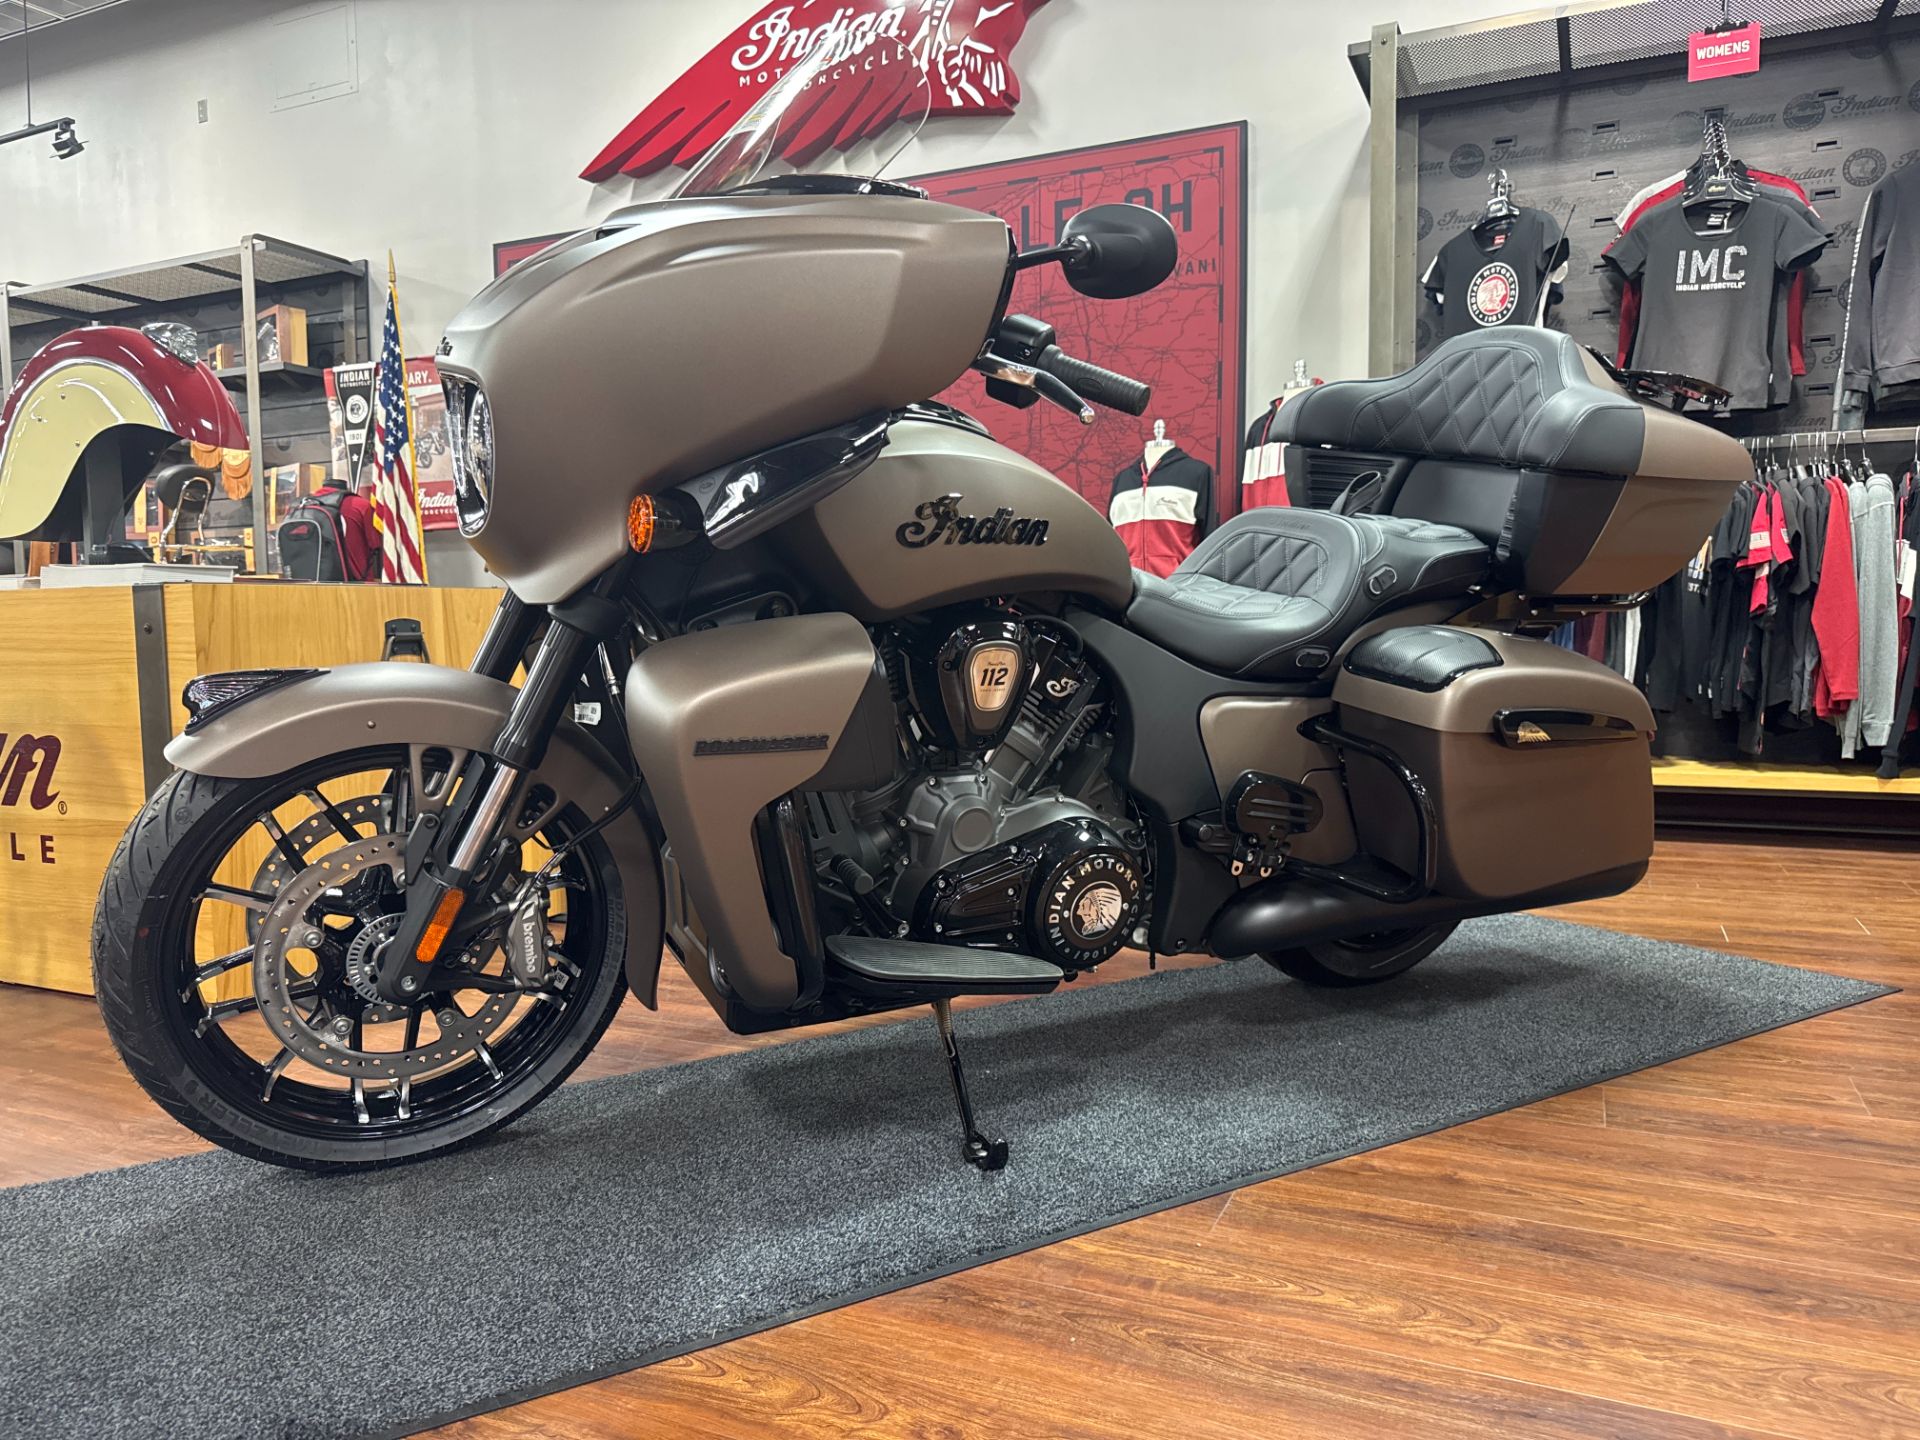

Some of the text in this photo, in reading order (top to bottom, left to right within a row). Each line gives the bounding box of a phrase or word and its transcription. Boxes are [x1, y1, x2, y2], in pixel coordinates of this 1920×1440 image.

[731, 6, 906, 71] Indian
[1696, 40, 1750, 60] WOMENS
[1831, 94, 1902, 114] Indian
[1489, 144, 1547, 163] Indian
[1676, 245, 1747, 283] IMC
[1676, 283, 1699, 291] INDIAN
[340, 370, 370, 383] INDIAN
[896, 492, 1050, 548] Indian
[980, 667, 1008, 687] 112
[1048, 858, 1141, 947] INDIAN MOTORCYCLE
[522, 921, 538, 974] brembo
